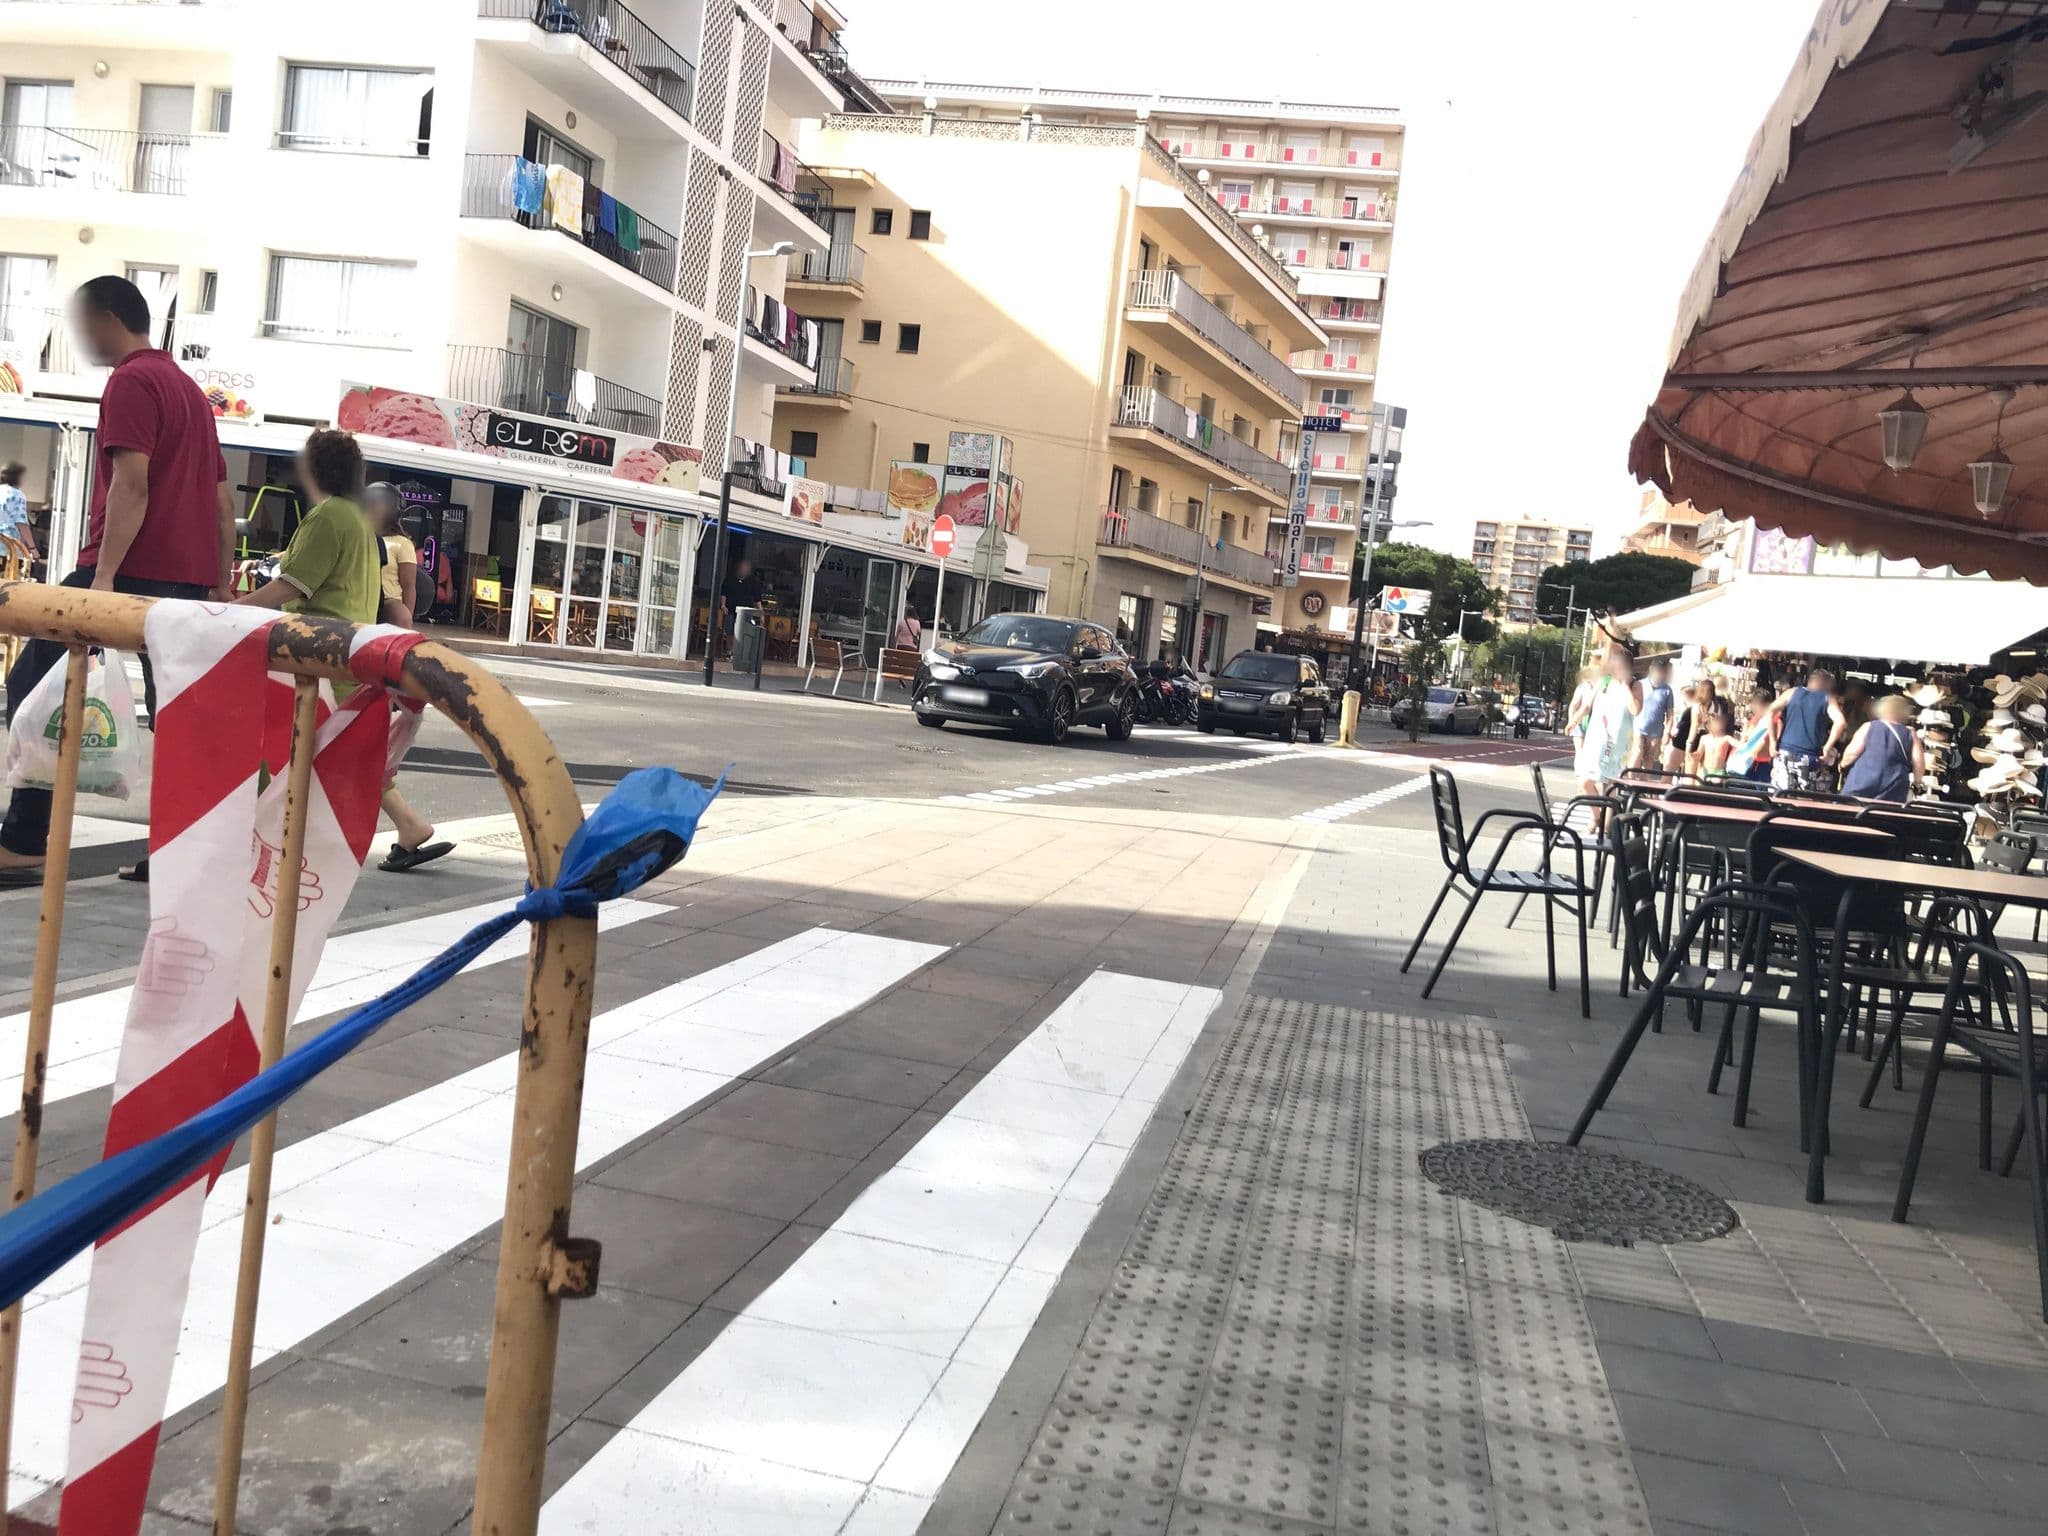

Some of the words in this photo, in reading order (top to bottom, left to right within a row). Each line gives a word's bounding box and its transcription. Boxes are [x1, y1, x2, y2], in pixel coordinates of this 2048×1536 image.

[495, 420, 534, 446] EL
[1303, 416, 1340, 427] HOTEL
[510, 451, 558, 467] GELATERIA
[566, 461, 613, 476] CAFETERIA
[1297, 433, 1312, 499] stella
[1287, 513, 1304, 575] maris
